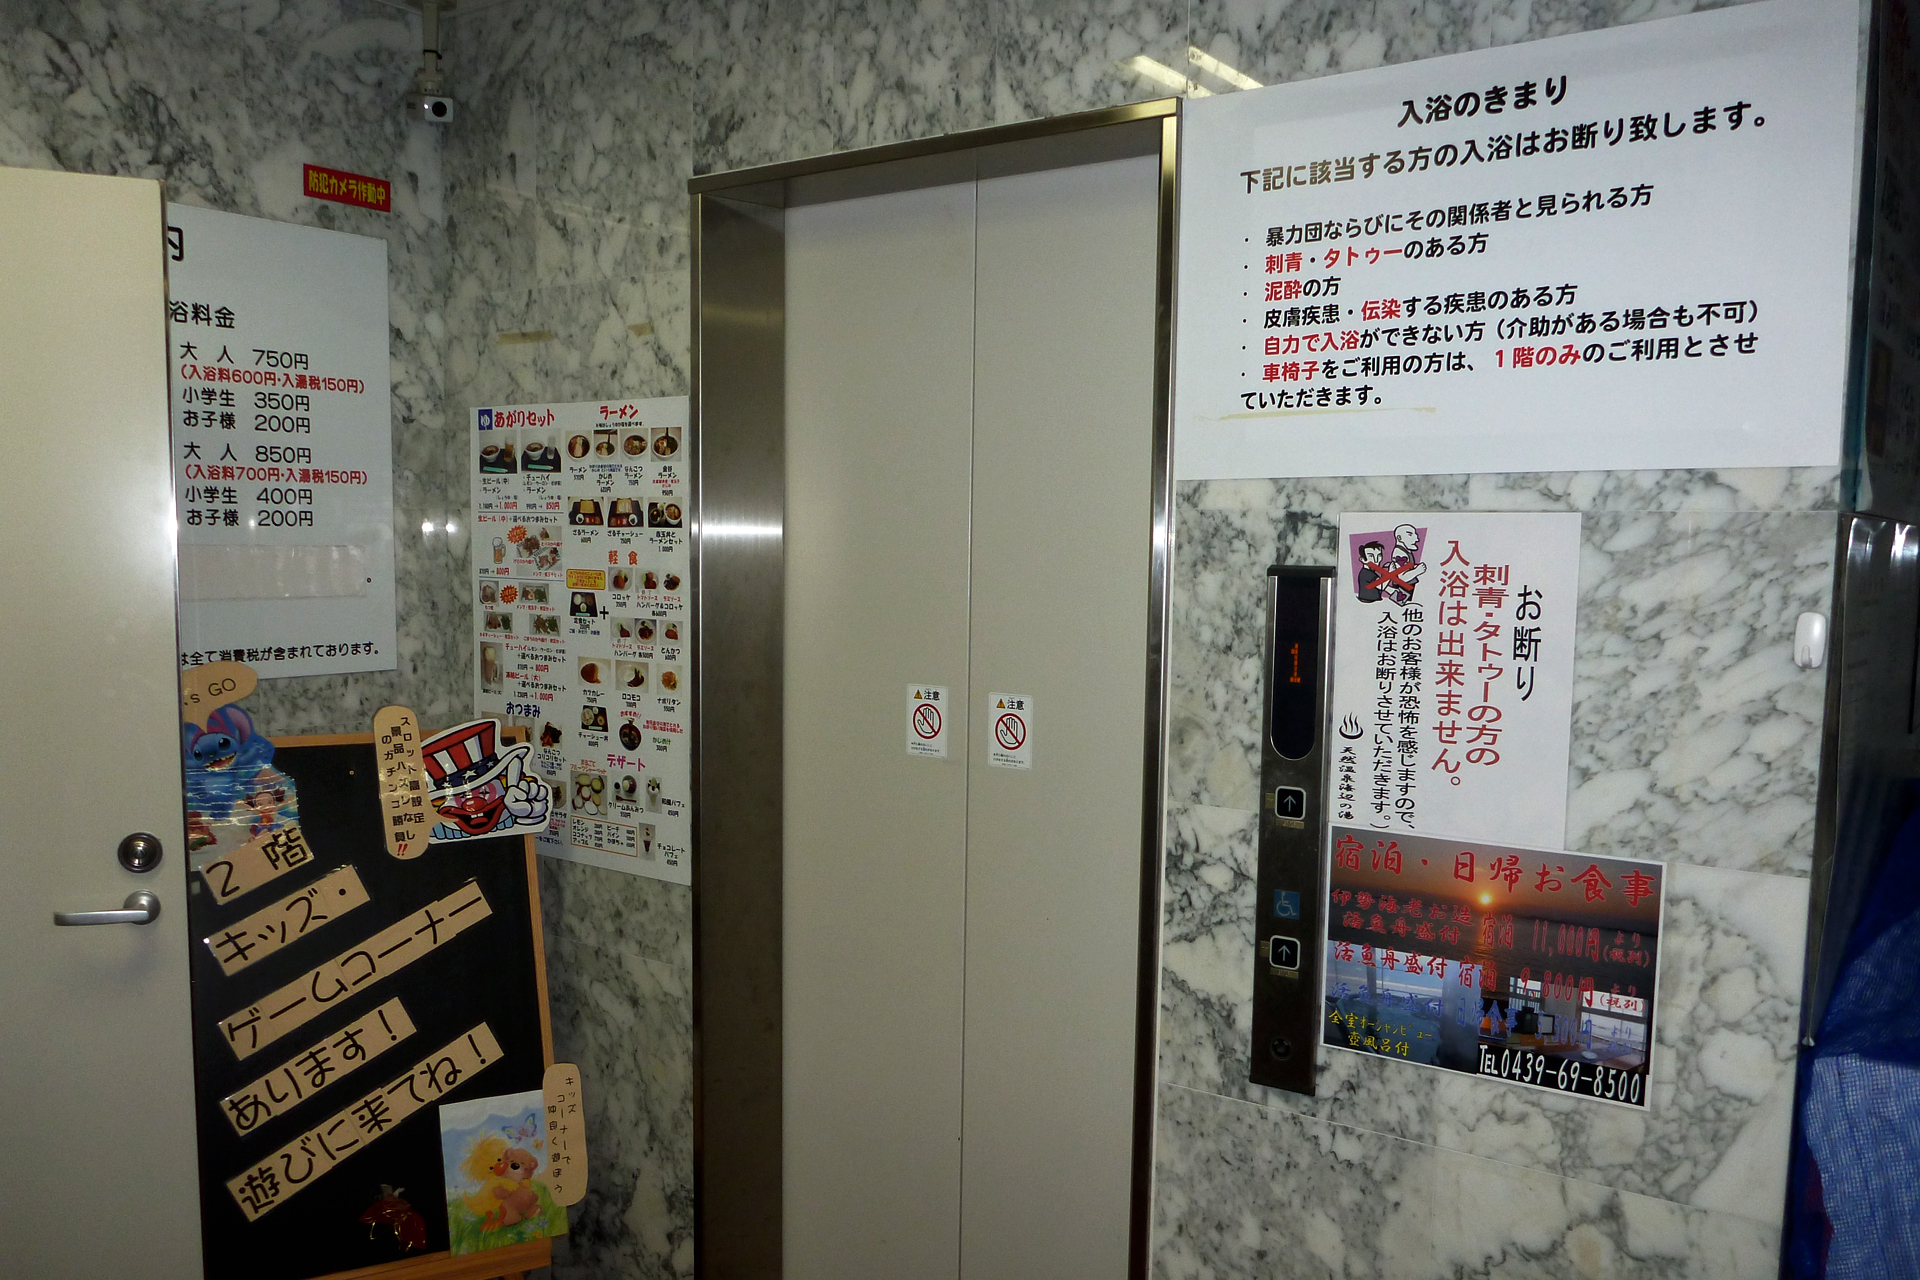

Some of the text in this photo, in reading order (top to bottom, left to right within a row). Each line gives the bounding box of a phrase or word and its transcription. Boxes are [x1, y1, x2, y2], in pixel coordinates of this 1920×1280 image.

[1397, 75, 1567, 128] 入浴のきまり
[1240, 101, 1765, 194] 下記に該当する方の入浴はお断り致します。
[308, 170, 386, 205] 防犯カメラ作動中
[1265, 232, 1489, 274] 刺青・タトゥーのある方
[1264, 276, 1342, 302] 泥酔の方
[1264, 283, 1578, 329] 皮膚疾患・伝染する疾患のある方
[252, 349, 309, 370] 750円
[182, 386, 310, 411] 小学生 350円
[1240, 384, 1383, 410] ていただきます。
[183, 411, 311, 433] お子様 200円
[600, 404, 638, 420] ラーメン
[255, 446, 312, 464] 850円
[184, 486, 313, 505] 小学生 400円
[187, 509, 314, 527] お子様 200円
[1512, 584, 1543, 702] お断り
[1289, 643, 1301, 683] 1
[1431, 540, 1470, 786] 入浴は出来ません。
[208, 678, 236, 697] GO
[583, 689, 605, 697] カツカレー
[622, 693, 641, 701] ロコモコ
[924, 690, 940, 701] 注意
[506, 702, 541, 718] おつまみ
[657, 697, 681, 705] ナポリタン
[1007, 699, 1025, 711] 注意
[607, 754, 646, 772] デザート
[608, 802, 644, 813] クリームあんみつ
[657, 843, 685, 853] チョコレート
[206, 827, 308, 898] 2階
[228, 896, 482, 1049] ゲームコーナー
[566, 1077, 577, 1114] キッズ
[239, 1034, 487, 1214] 遊びに来てね!
[557, 1094, 571, 1165] コーナーで
